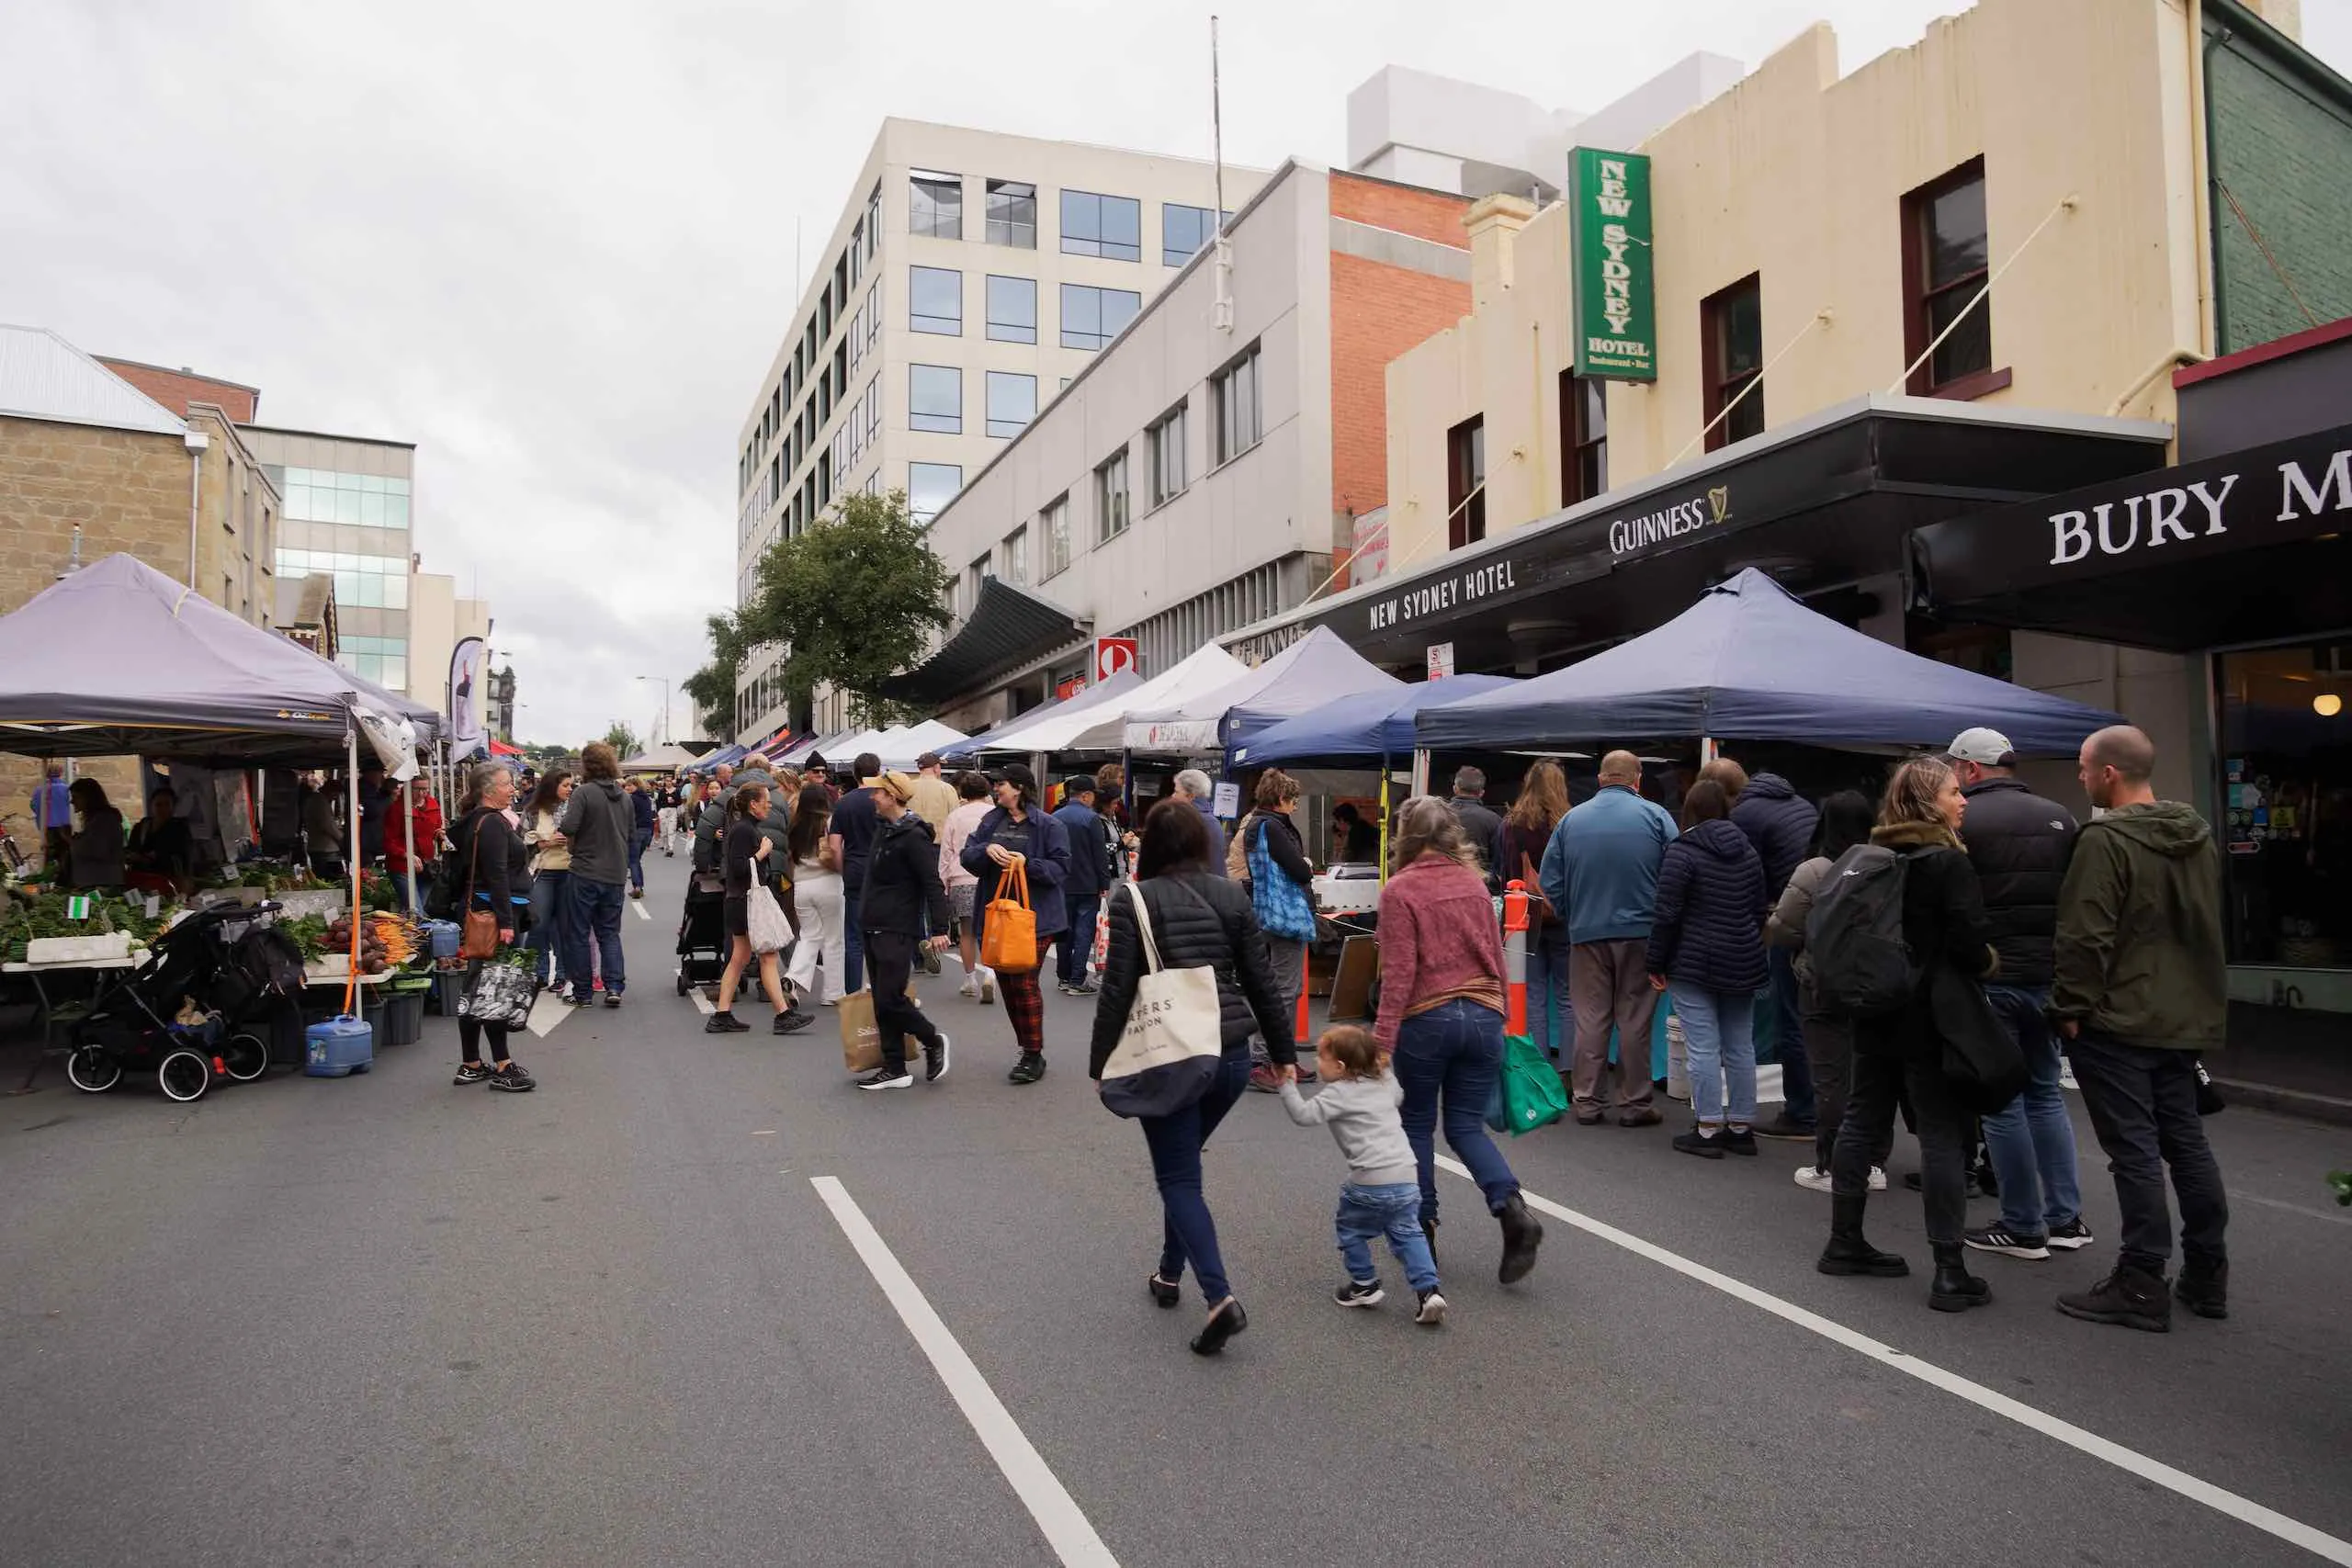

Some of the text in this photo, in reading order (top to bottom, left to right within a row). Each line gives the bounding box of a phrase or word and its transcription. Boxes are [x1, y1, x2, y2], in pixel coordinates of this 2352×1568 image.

[1596, 159, 1633, 334] NEW SYDNEY
[1588, 337, 1650, 357] HOTEL
[1609, 497, 1704, 555] GUINNESS
[2049, 474, 2240, 565] BURY
[1370, 560, 1516, 631] NEW SYDNEY HOTEL
